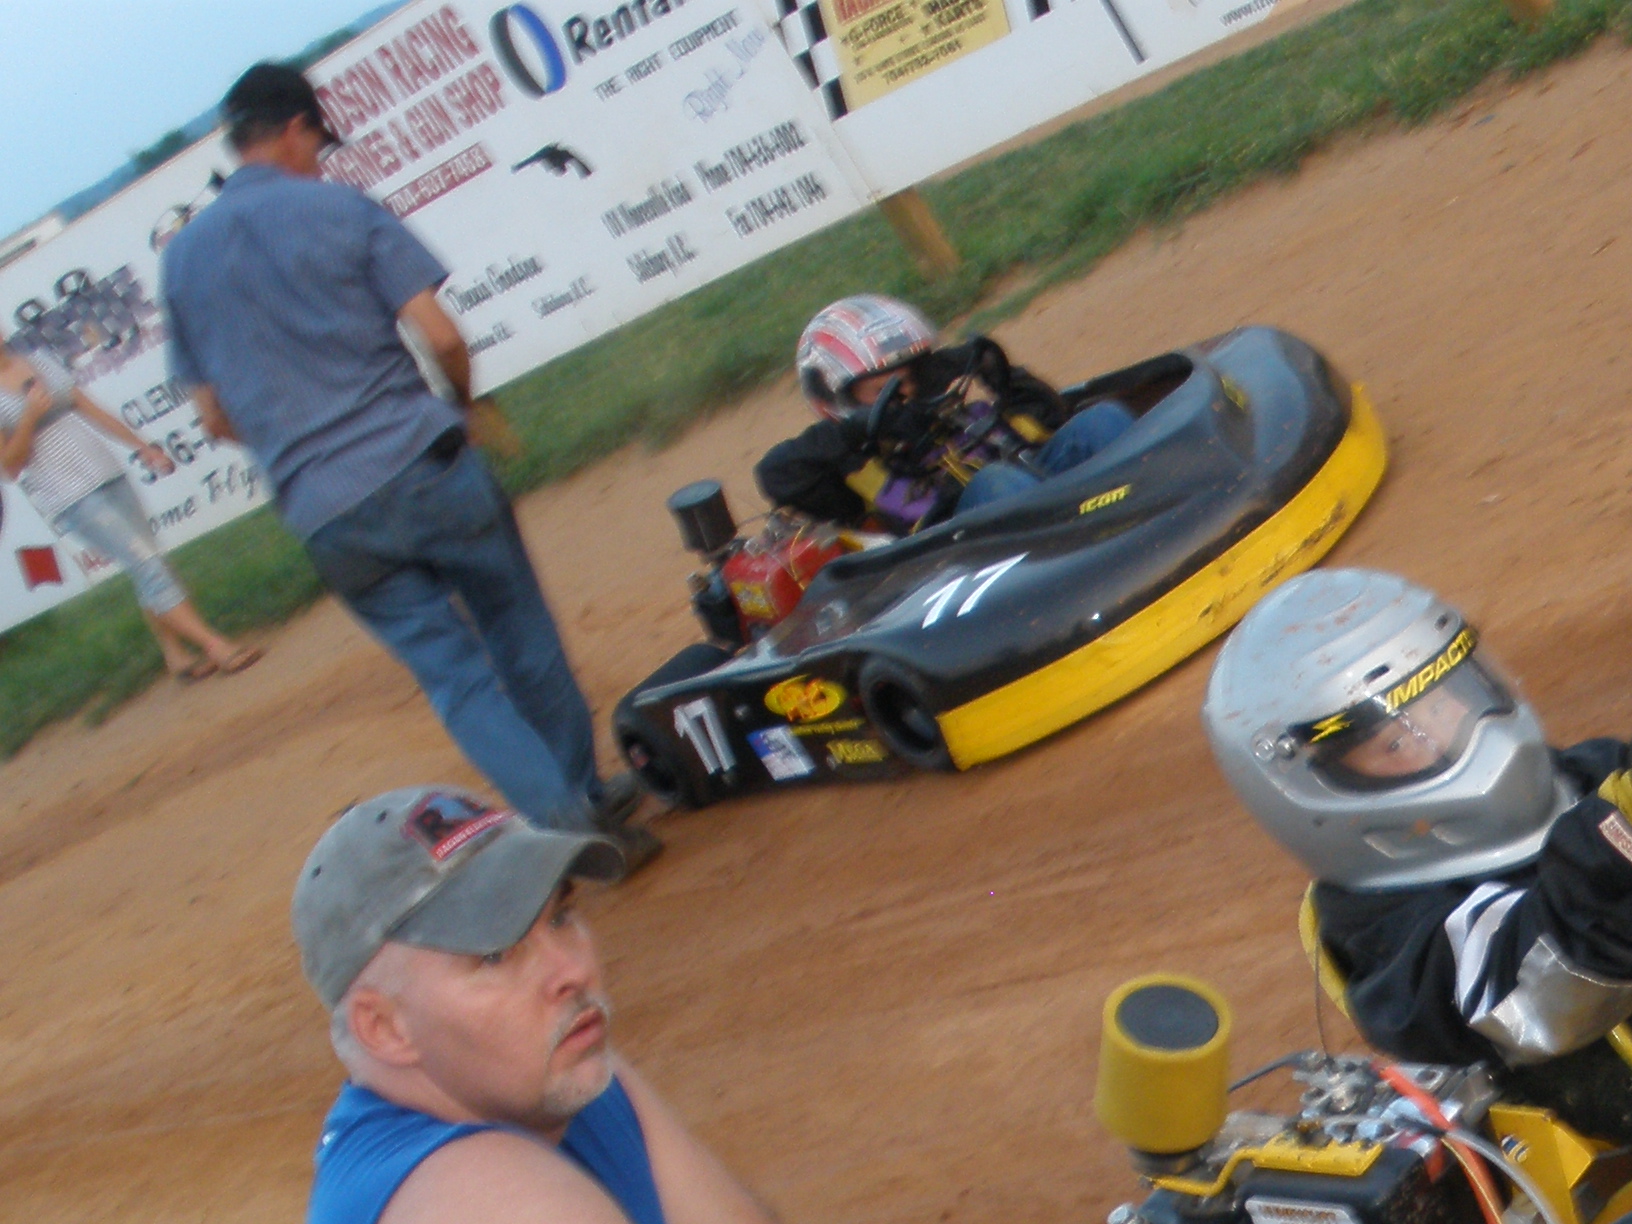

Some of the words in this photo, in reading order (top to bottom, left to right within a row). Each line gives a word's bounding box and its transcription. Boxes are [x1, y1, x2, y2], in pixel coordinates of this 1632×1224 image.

[375, 5, 480, 99] RACING
[594, 75, 622, 101] THE
[624, 51, 664, 85] RIGHT
[667, 9, 739, 60] EQUIPMENT
[404, 92, 460, 153] GUN
[442, 61, 506, 130] SHOP
